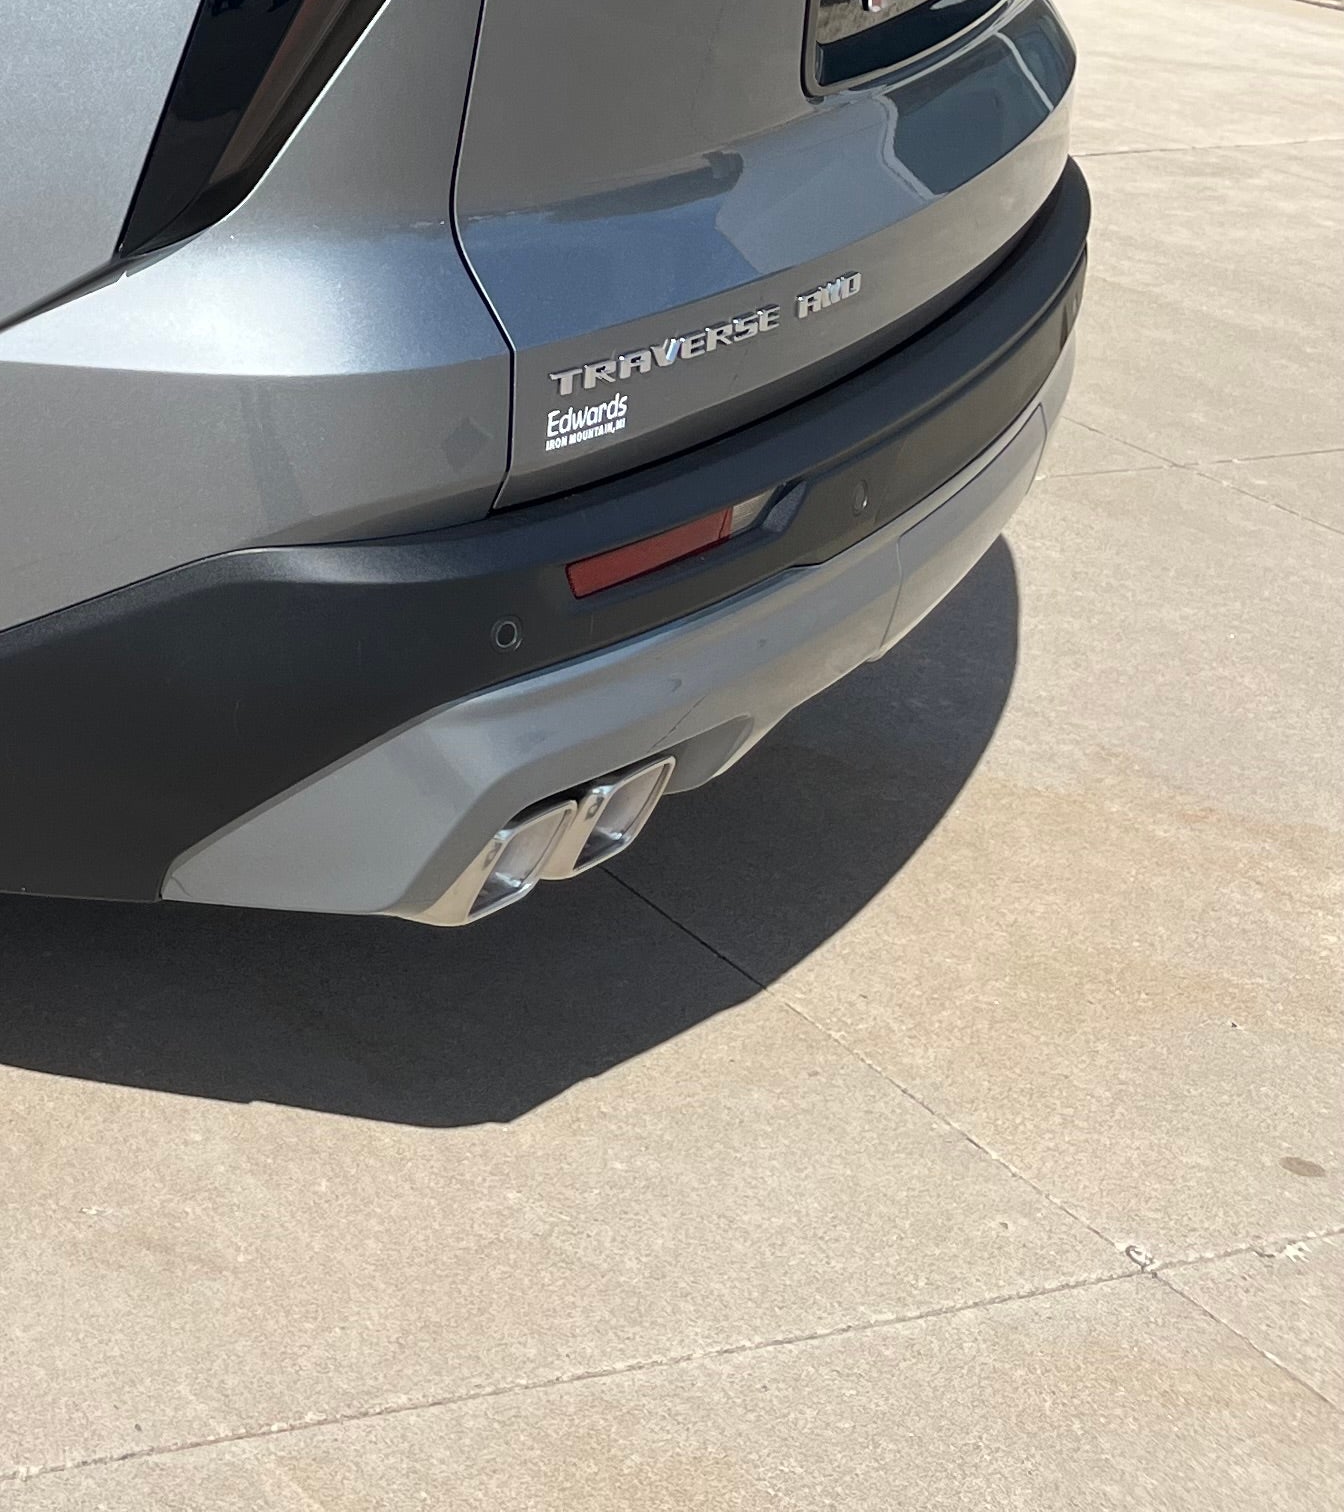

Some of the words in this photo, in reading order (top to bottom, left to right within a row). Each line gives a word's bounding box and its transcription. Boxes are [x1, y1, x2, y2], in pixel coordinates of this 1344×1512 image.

[548, 303, 780, 396] TRAVERSE
[795, 270, 863, 320] AWD
[546, 392, 628, 438] Edwards
[545, 435, 568, 451] IRON
